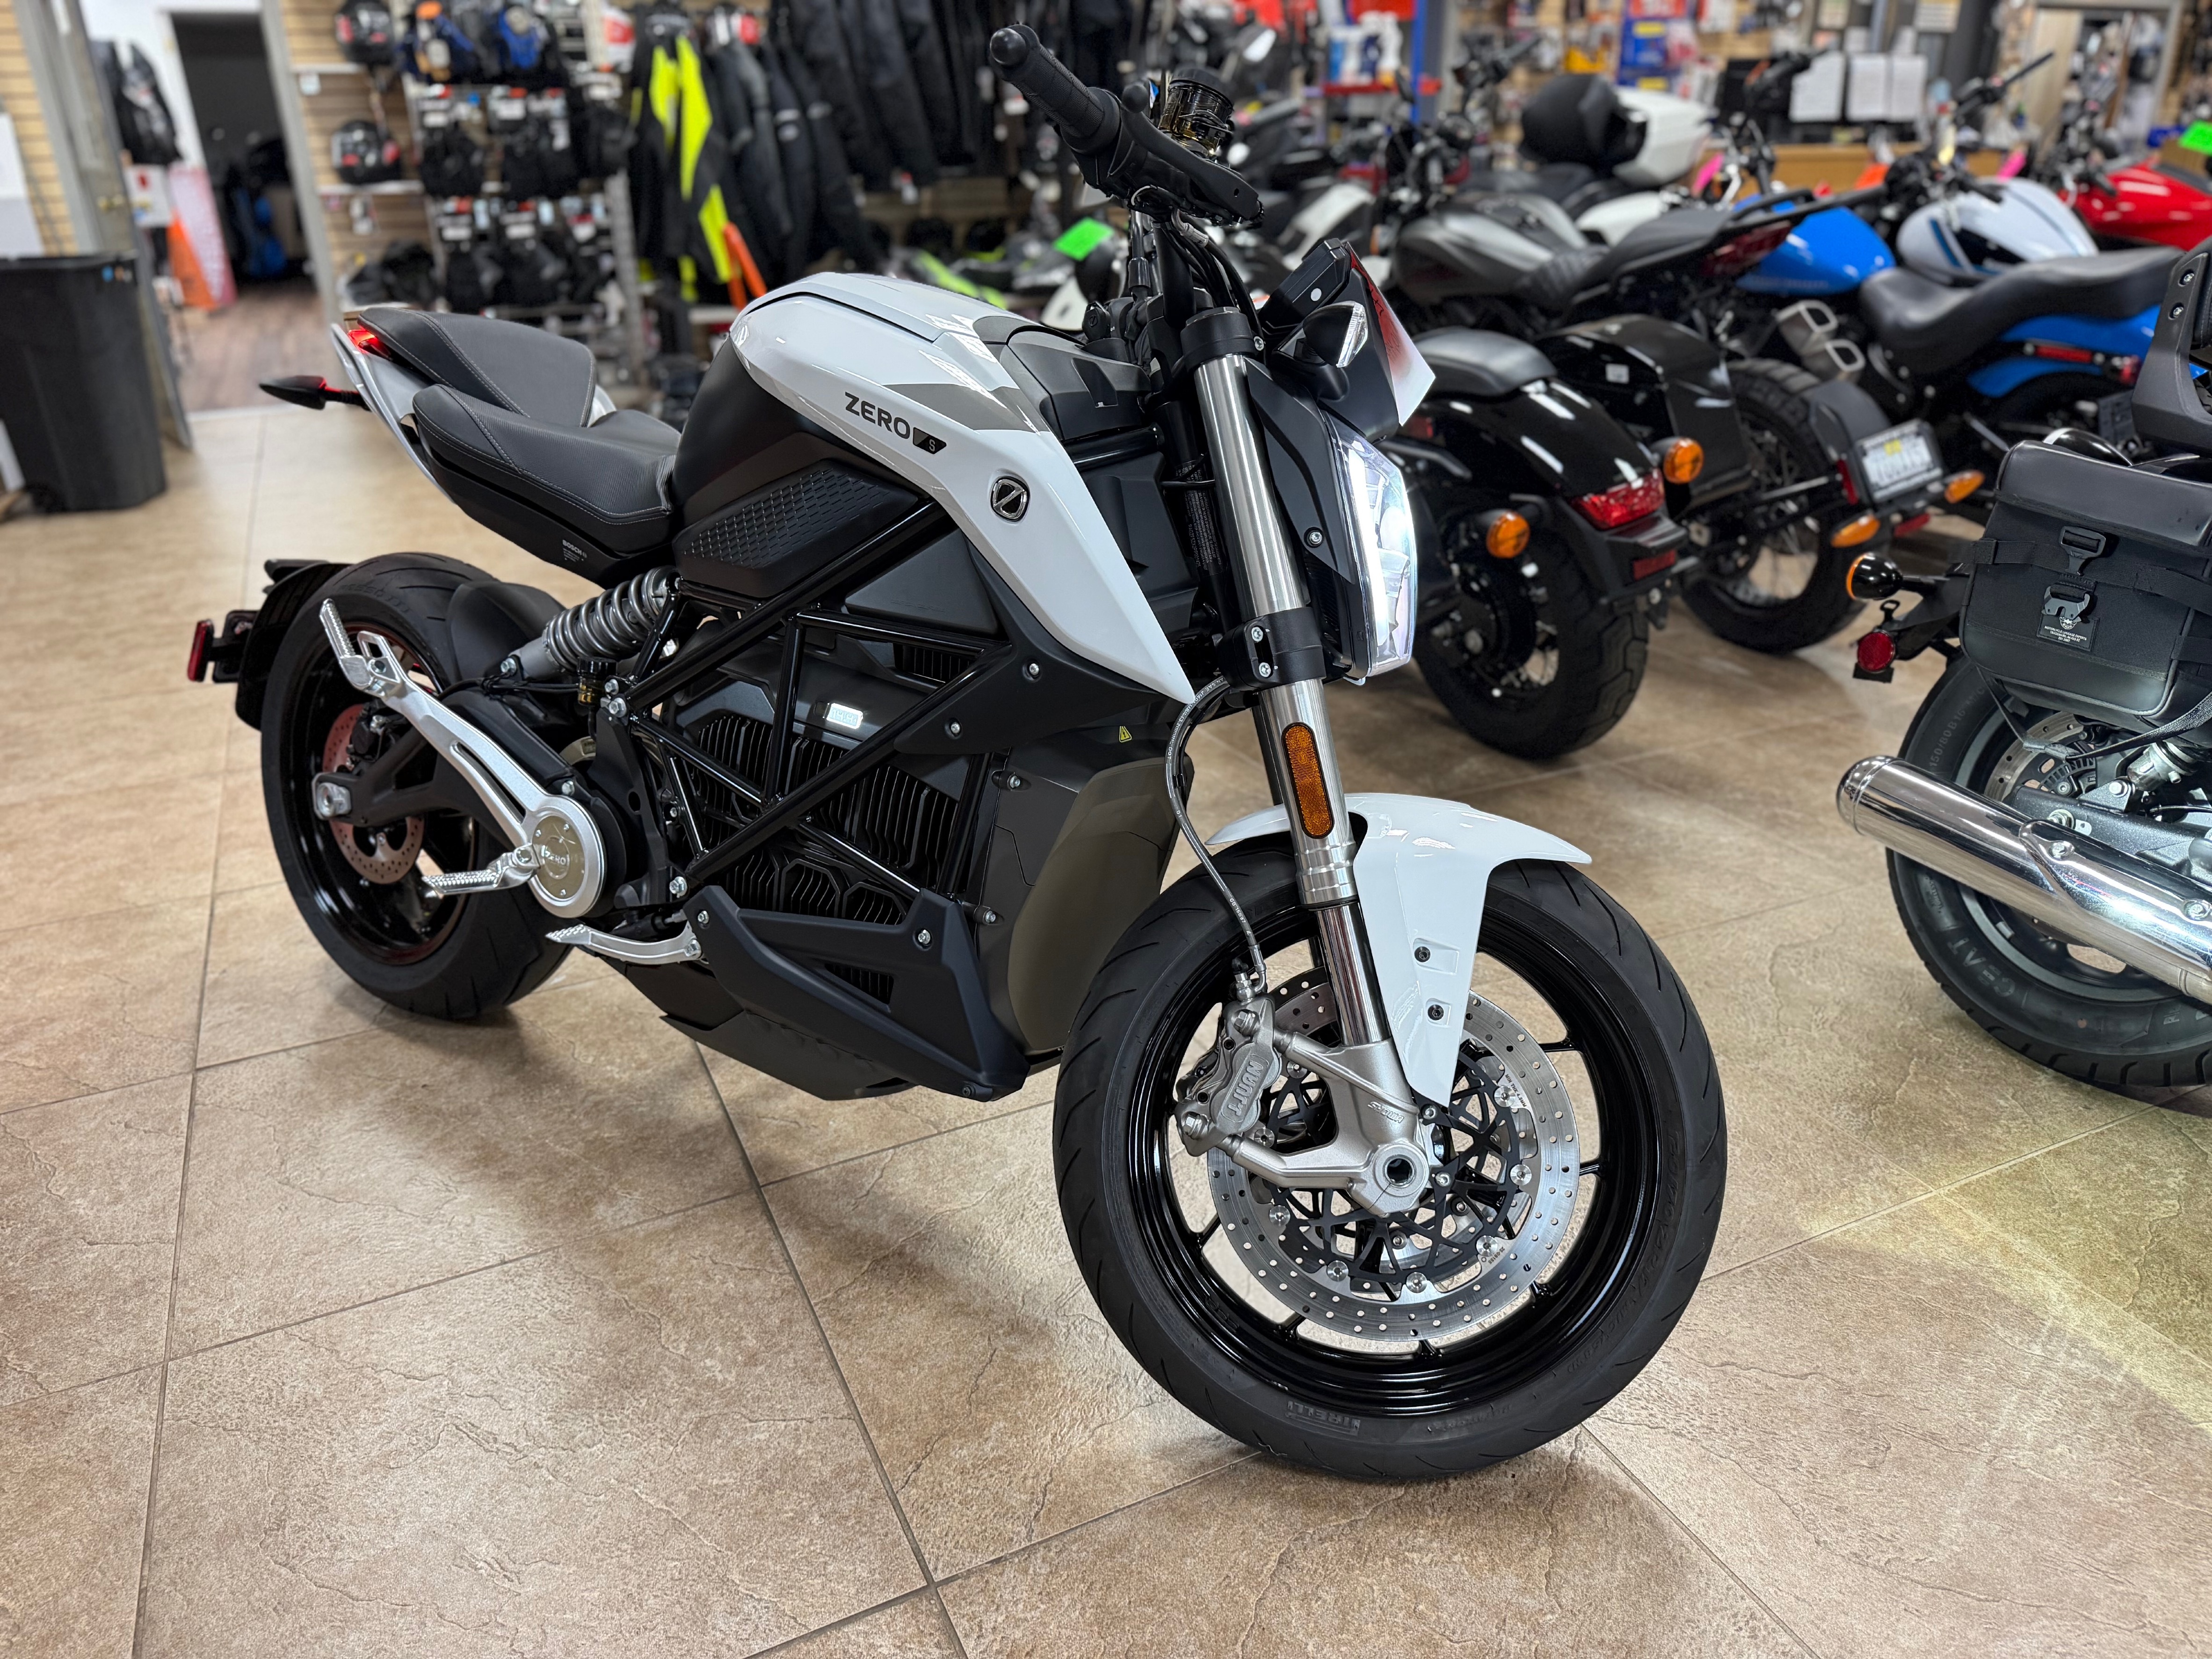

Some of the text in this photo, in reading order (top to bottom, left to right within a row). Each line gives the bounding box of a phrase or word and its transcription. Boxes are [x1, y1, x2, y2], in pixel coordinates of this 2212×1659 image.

[845, 392, 936, 452] ZERO S
[563, 539, 582, 555] BOSCH
[1204, 682, 1216, 692] SAE
[1228, 1060, 1263, 1116] J.JUAN
[1504, 1073, 1513, 1084] MIN
[1367, 1101, 1405, 1124] SHOWA
[1285, 1400, 1361, 1437] PIRELLI
